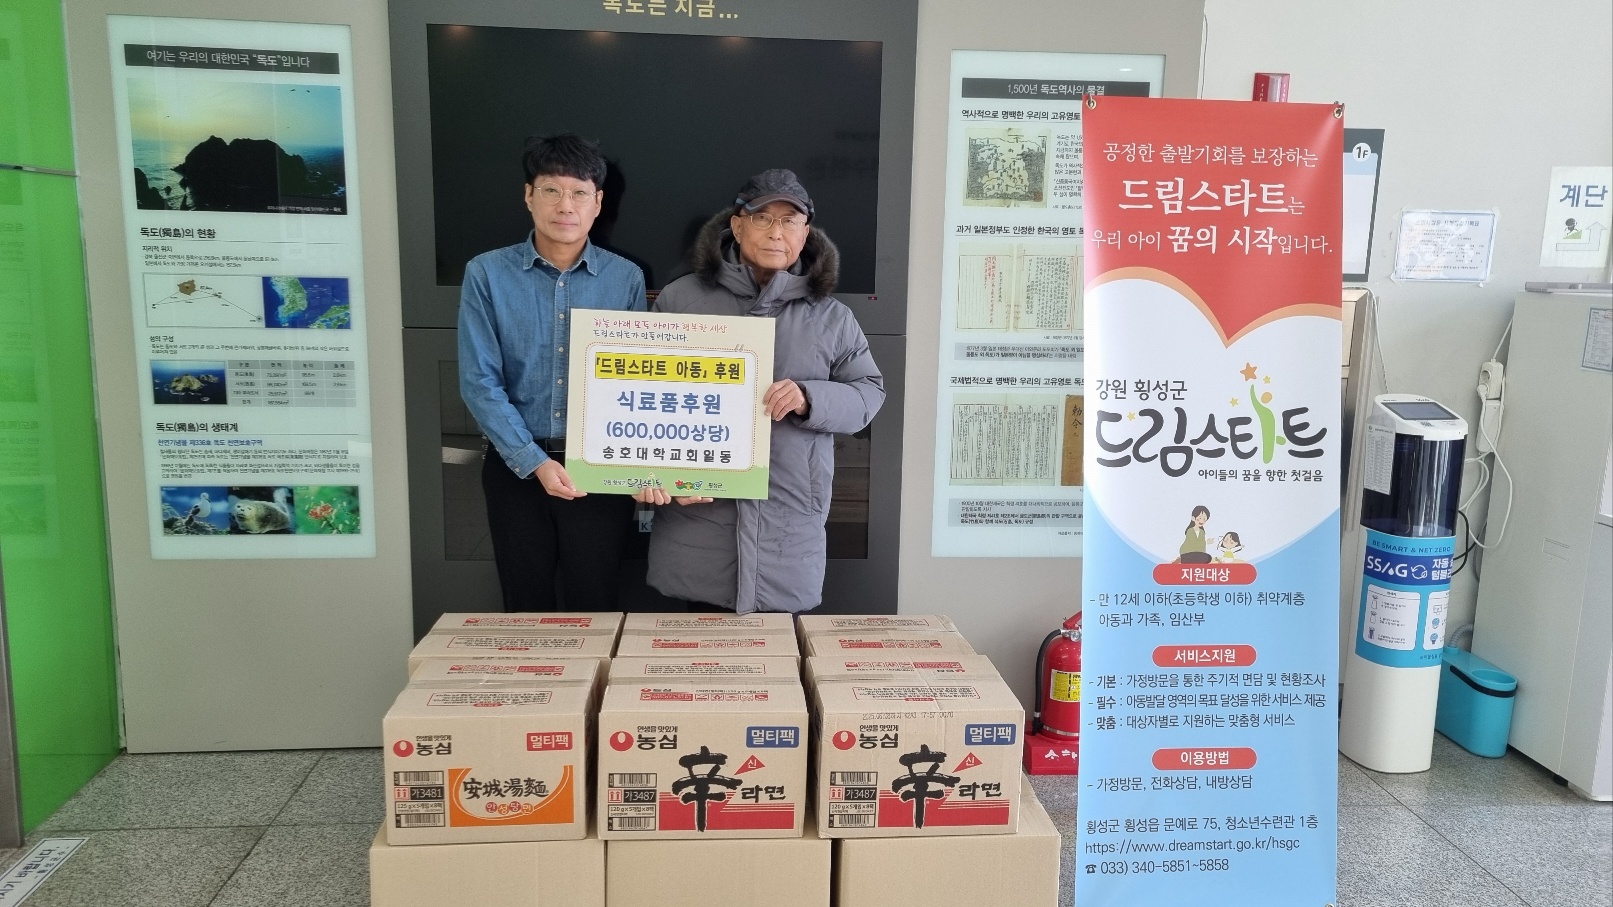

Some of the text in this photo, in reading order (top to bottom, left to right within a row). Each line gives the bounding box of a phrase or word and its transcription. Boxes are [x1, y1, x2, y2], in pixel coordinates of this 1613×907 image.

[146, 50, 176, 62] 여기는
[179, 51, 209, 63] 우리의
[211, 52, 250, 65] 대한민국
[1007, 84, 1038, 95] 1,500년
[1040, 85, 1084, 95] 독도역사의
[961, 109, 1081, 121] 역사적으로 명백한 우리의 고유영토
[1103, 143, 1154, 163] 공정한
[1160, 144, 1246, 165] 출발기회를
[1251, 147, 1318, 168] 보장하는
[1356, 145, 1368, 158] 1F
[1119, 177, 1305, 217] 드림스타트는
[1560, 184, 1608, 208] 계단
[197, 228, 216, 239] 현황
[956, 225, 1076, 235] 과거 일본정부도 인정한 한국의 영토
[1091, 225, 1333, 256] 우리 아이 꿈의 시작입니다.
[613, 319, 631, 330] 아래
[633, 320, 650, 330] 모든
[653, 321, 680, 331] 아이가
[681, 323, 708, 333] 행복한
[710, 324, 728, 334] 세상
[593, 329, 639, 340] 드림스타트가
[715, 362, 740, 380] 후원
[950, 377, 993, 385] 국제법적으로
[996, 377, 1017, 385] 명백한
[1020, 377, 1041, 386] 우리의
[1043, 378, 1072, 386] 고유영토
[1095, 379, 1187, 401] 강원 횡성군
[617, 390, 721, 415] 식료품후원
[211, 422, 239, 433] 생태계
[606, 421, 730, 442] (600,000상당)
[1096, 384, 1327, 477] 드림스타트
[1198, 469, 1324, 482] 아이들의 꿈을 향한 첫걸음
[1382, 543, 1408, 553] SMART
[1432, 558, 1449, 569] 자동
[1181, 567, 1231, 583] 지원대상
[1098, 591, 1306, 607] 만 12세 이하(초등학생 이하) 취약계층
[1099, 612, 1206, 627] 아동과 가족, 임산부
[1174, 649, 1236, 663] 서비스지원
[1096, 675, 1117, 689] 기본
[1126, 674, 1180, 689] 가정방문을
[1182, 673, 1205, 688] 통한
[1207, 673, 1240, 687] 주기적
[1242, 673, 1264, 687] 면담
[1266, 673, 1277, 687] 및
[1280, 673, 1326, 688] 현황조사
[1096, 693, 1326, 710] 필수 아동발달 영역의 목표 달성을 위한 서비스 제공
[1096, 713, 1295, 731] 맞춤 대상자별로 지원하는 맞춤형 서비스
[530, 734, 569, 748] 멀티팩
[637, 734, 678, 750] 농심
[751, 729, 795, 746] 멀티팩
[859, 733, 898, 749] 농심
[970, 727, 1012, 742] 멀티팩
[416, 742, 452, 756] 농심
[748, 758, 757, 769] 신
[966, 756, 975, 766] 신
[1181, 751, 1230, 765] 이용방법
[672, 745, 743, 832] 辛
[892, 744, 960, 829] 辛
[1096, 774, 1253, 792] 가정방문, 전화상담, 내방상담
[412, 788, 442, 798] 가3481
[625, 791, 655, 801] 가3487
[741, 785, 786, 803] 라면
[846, 790, 875, 799] 가3487
[958, 782, 1002, 800] 라면
[1086, 815, 1319, 834] 횡성군 횡성읍 문예로 75, 청소년수련관 1층
[1085, 836, 1300, 855] https://www.dreamstart.go.kr/hsgc
[1100, 861, 1129, 875] 033)
